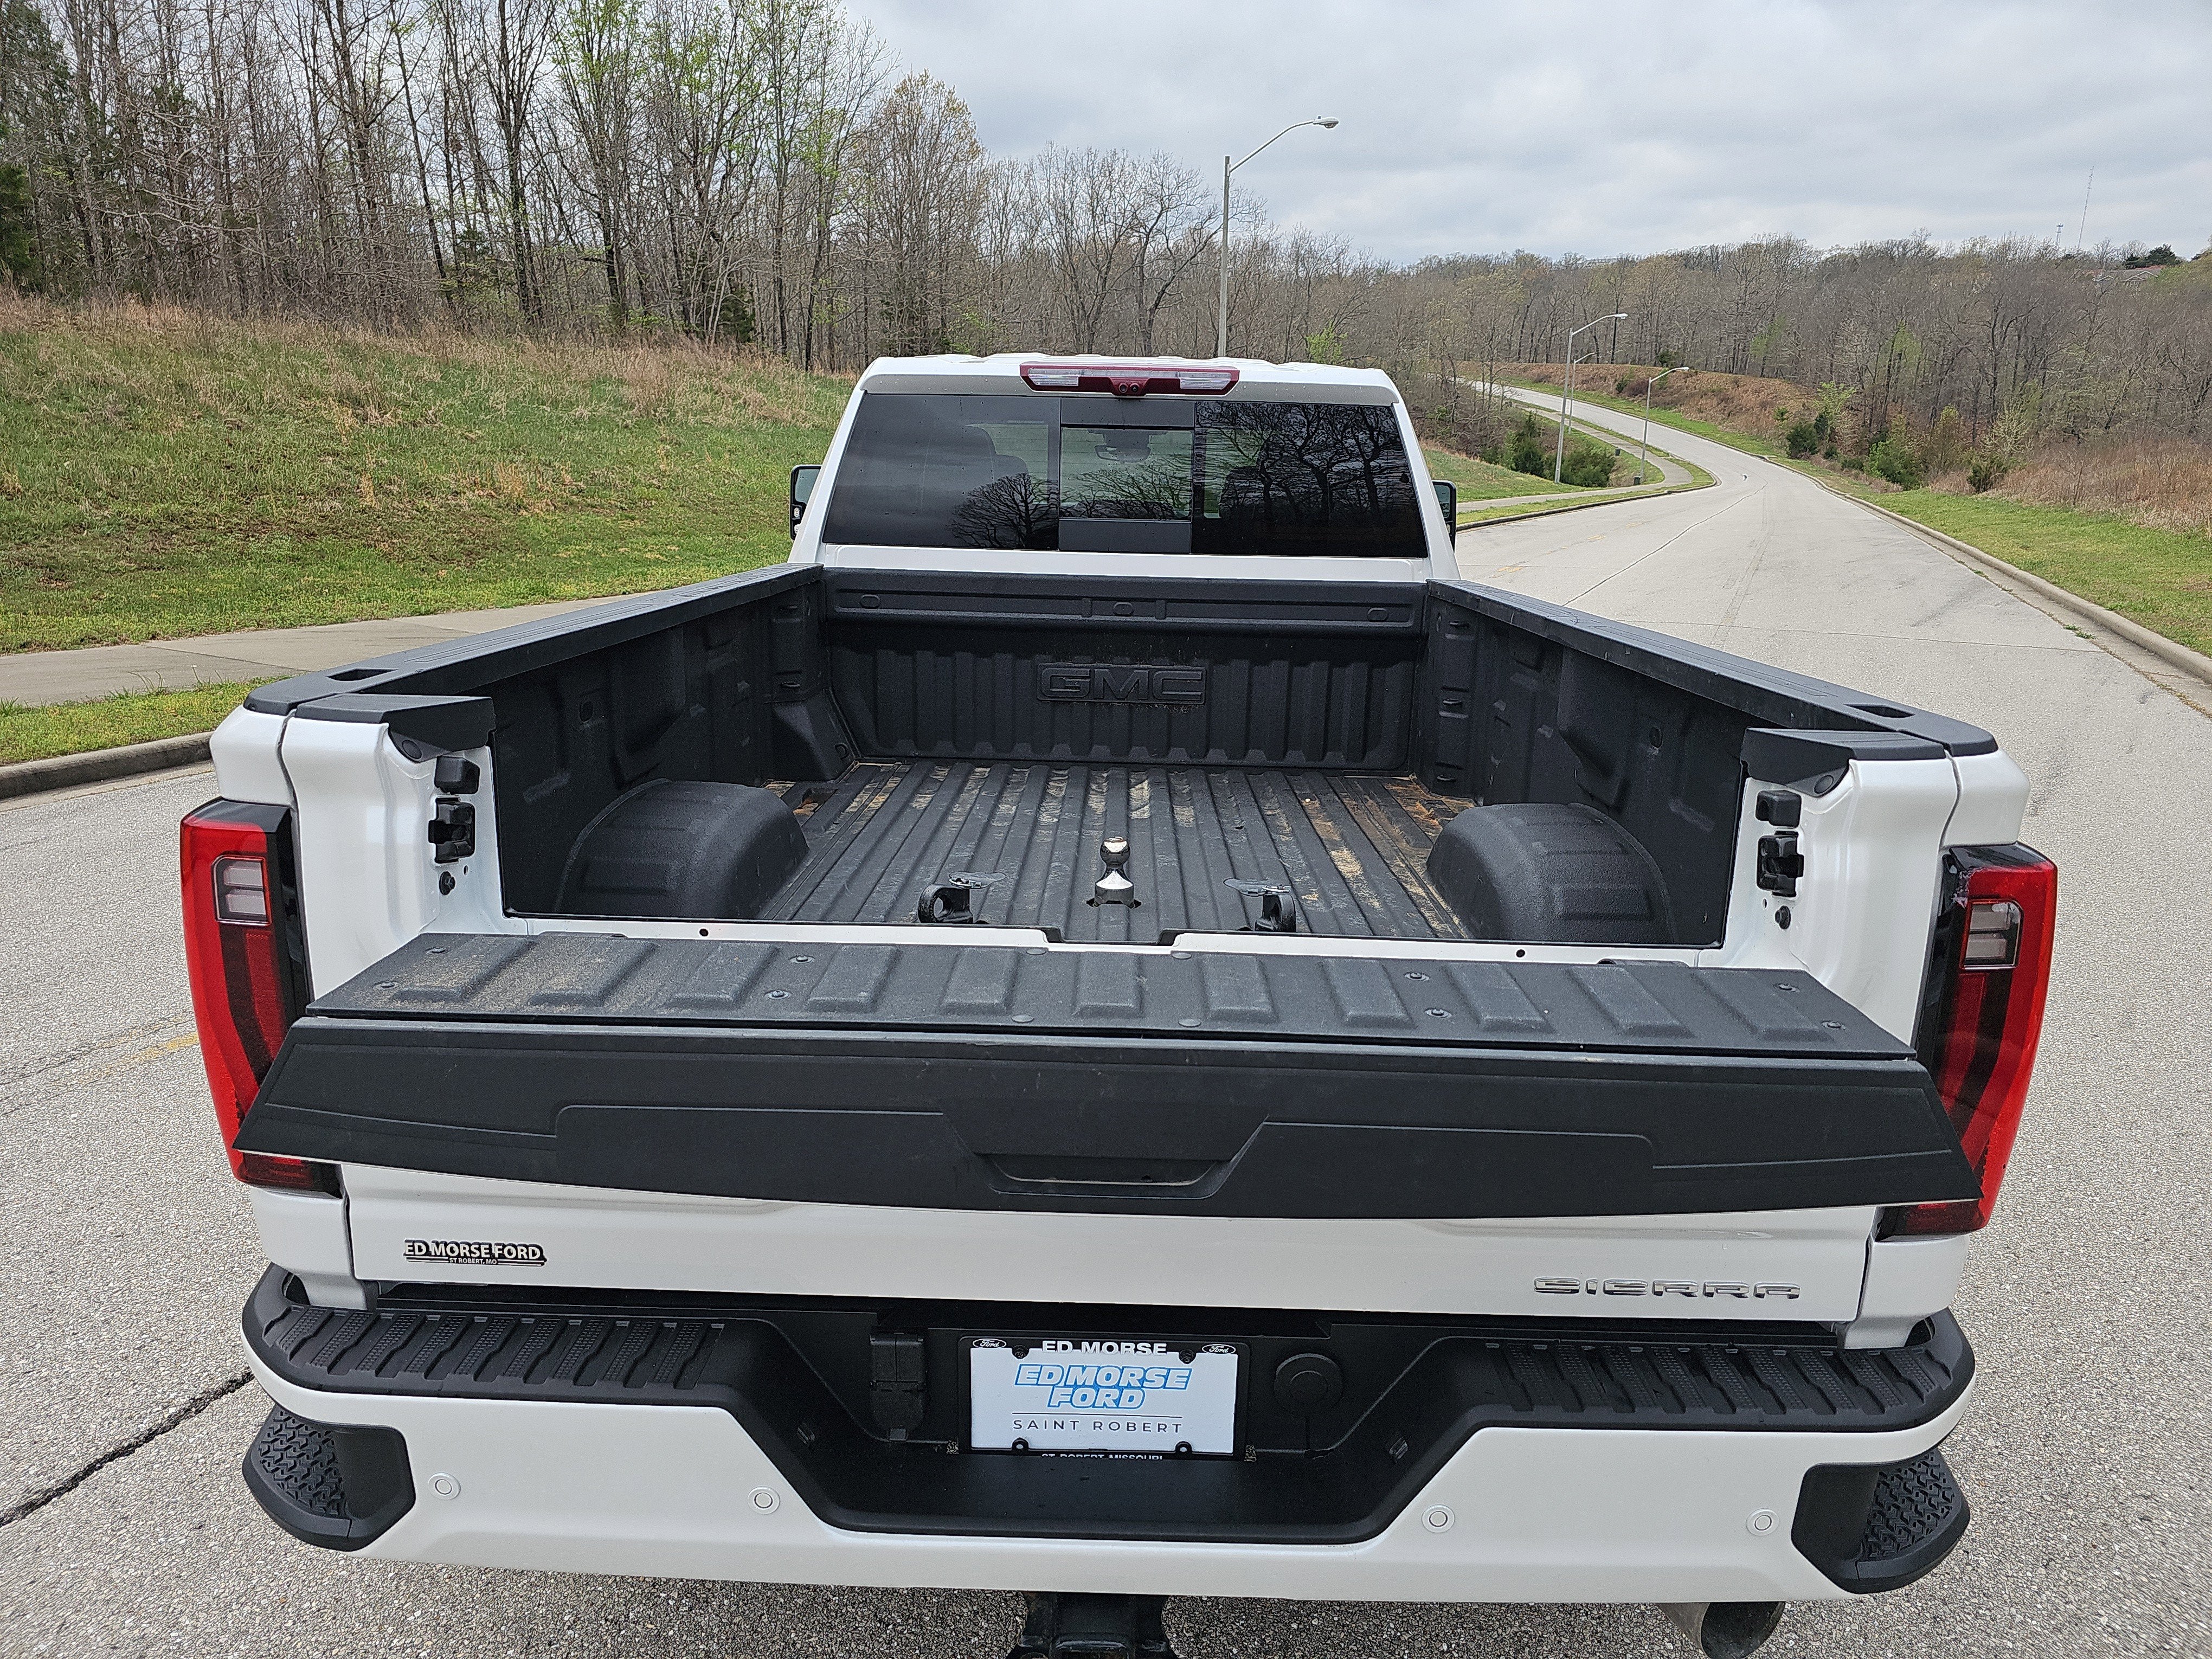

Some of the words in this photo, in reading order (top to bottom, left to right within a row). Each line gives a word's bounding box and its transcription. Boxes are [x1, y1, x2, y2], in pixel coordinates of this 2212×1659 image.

[1041, 667, 1203, 701] GMC
[405, 1242, 427, 1255] ED
[431, 1243, 490, 1257] MORSE
[494, 1245, 540, 1259] FORD
[1534, 1277, 1801, 1299] SIERRA
[980, 1340, 999, 1348] Ford
[1043, 1341, 1072, 1353] ED
[1081, 1341, 1167, 1355] MORSE
[1209, 1345, 1229, 1354] Ford
[1014, 1364, 1064, 1386] ED
[1063, 1365, 1193, 1390] MORSE
[1047, 1386, 1145, 1410] FORD
[1013, 1419, 1079, 1431] SAINT
[1093, 1422, 1182, 1433] ROBERT
